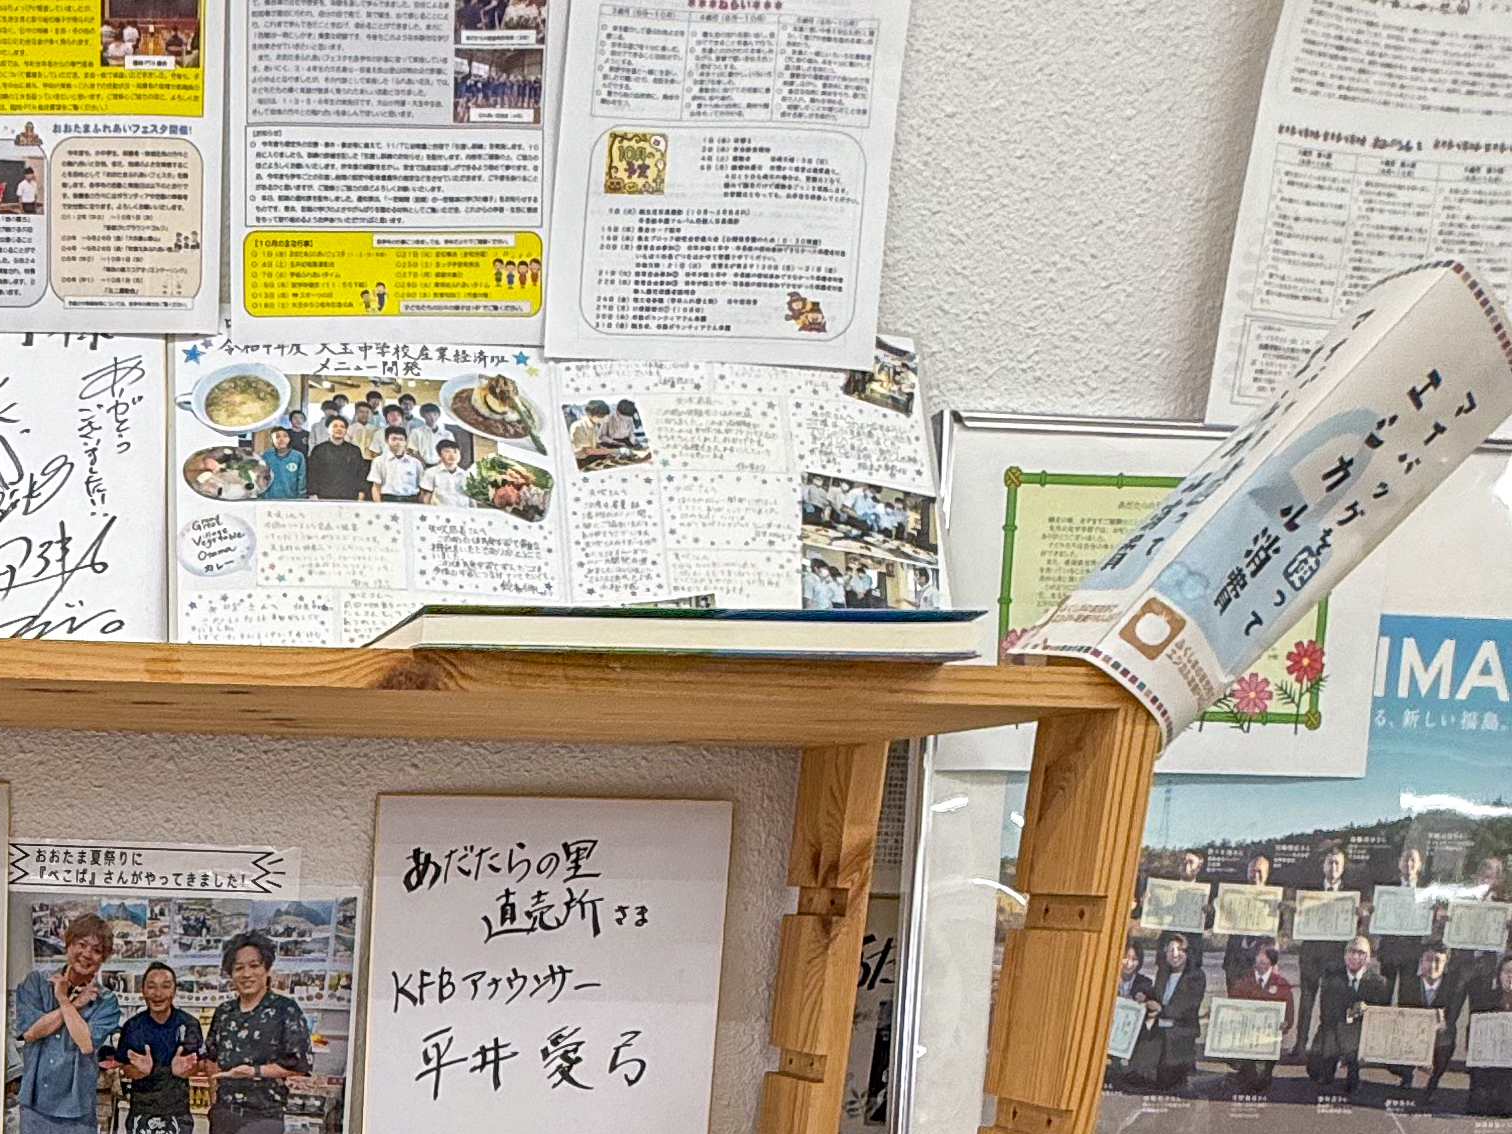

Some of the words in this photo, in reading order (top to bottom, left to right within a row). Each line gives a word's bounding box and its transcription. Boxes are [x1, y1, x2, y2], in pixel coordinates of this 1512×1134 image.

[35, 848, 144, 868] おおたま夏祭りに
[402, 838, 602, 893] あだたらの里
[482, 887, 605, 945] 直売所
